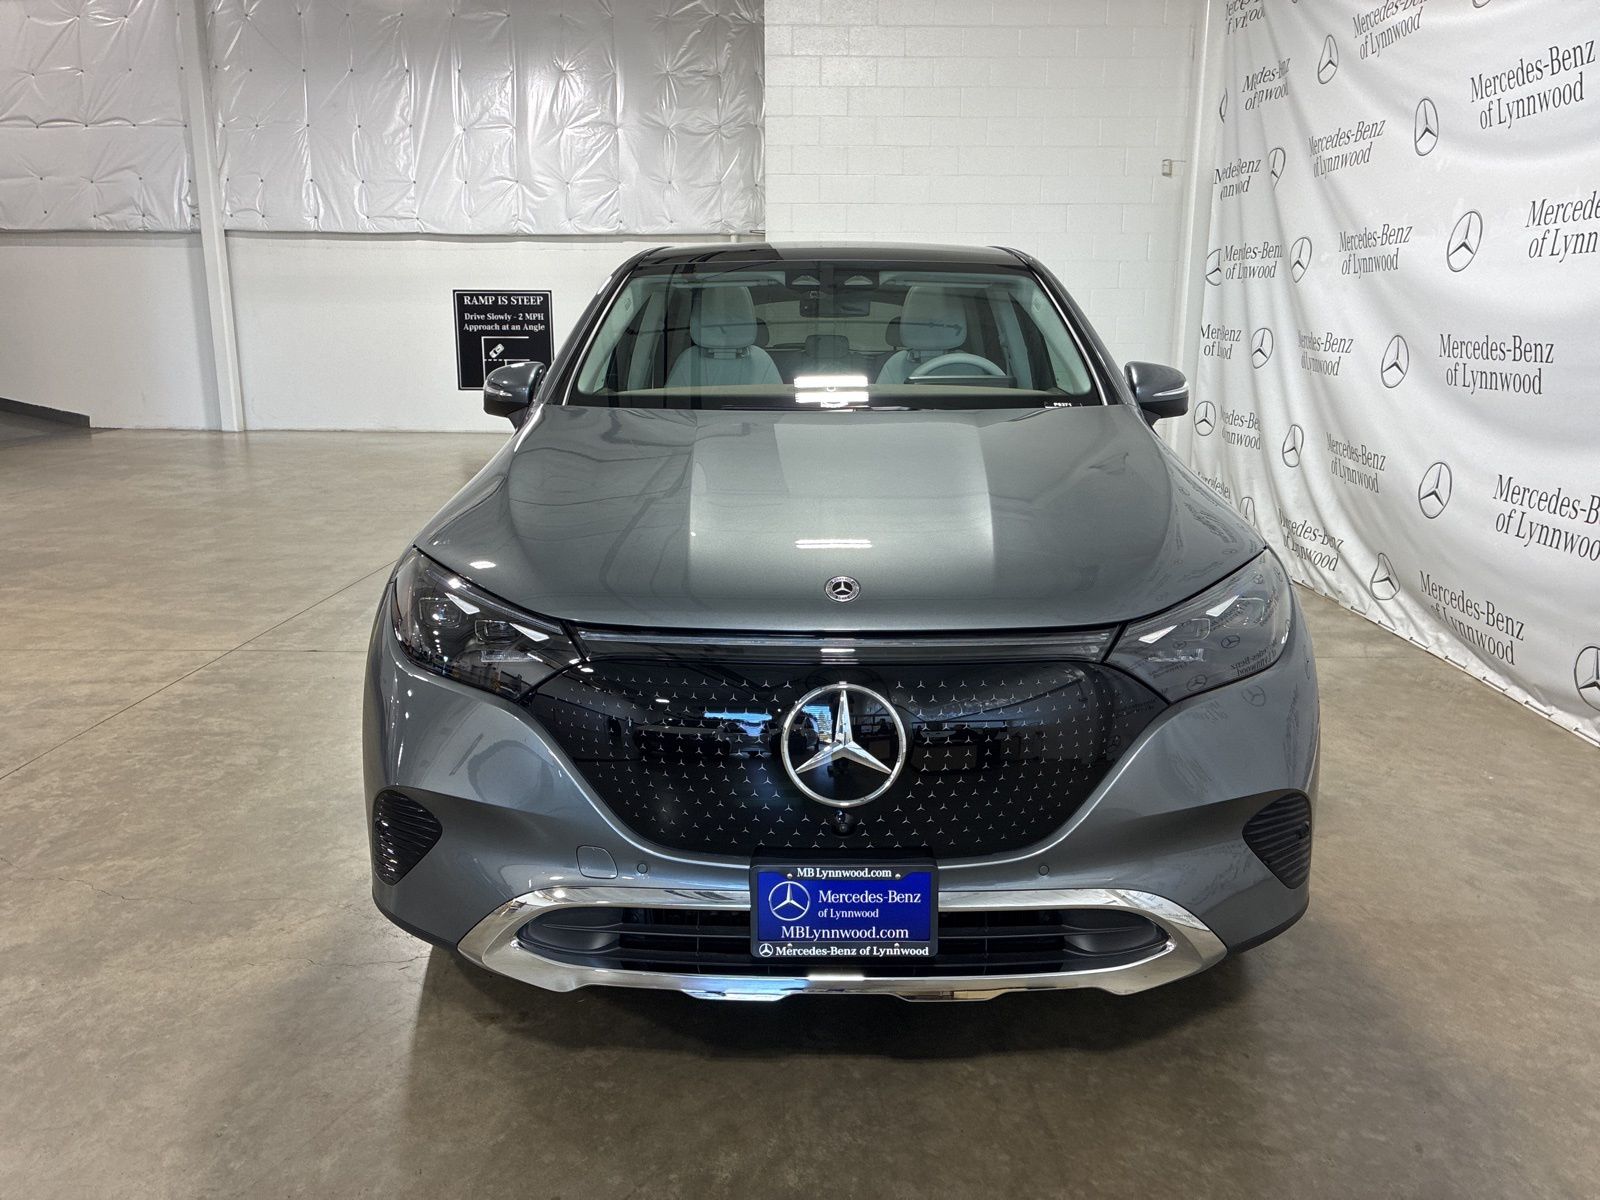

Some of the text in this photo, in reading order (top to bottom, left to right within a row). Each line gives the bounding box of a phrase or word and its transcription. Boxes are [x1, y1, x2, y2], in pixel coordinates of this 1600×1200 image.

[1360, 6, 1423, 60] of Lynnwood
[1470, 40, 1596, 103] Mercedes-Benz
[1480, 71, 1584, 130] of Lynnwood
[1320, 141, 1373, 180] Lynnwood
[1338, 223, 1413, 253] Mercedes-Benz
[1528, 228, 1550, 259] of
[1225, 263, 1237, 280] of
[1341, 247, 1400, 279] of Lynnwood
[463, 296, 544, 305] RAMP IS STEEP
[463, 323, 500, 332] Approach
[523, 323, 545, 332] Angle
[486, 313, 512, 322] Slowly
[1203, 341, 1216, 357] of
[1439, 333, 1554, 364] Mercedes-Benz
[1446, 362, 1543, 395] of Lynnwood
[1338, 458, 1380, 494] Lynnwood
[1495, 508, 1516, 534] of
[1420, 569, 1525, 641] Mercedes-Benz
[818, 890, 921, 903] Mercedes-Benz
[818, 908, 879, 919] of Lynnwood
[781, 926, 909, 942] MBLynnwood.com
[775, 945, 929, 957] Mercedes-Benz of Lynnwood
